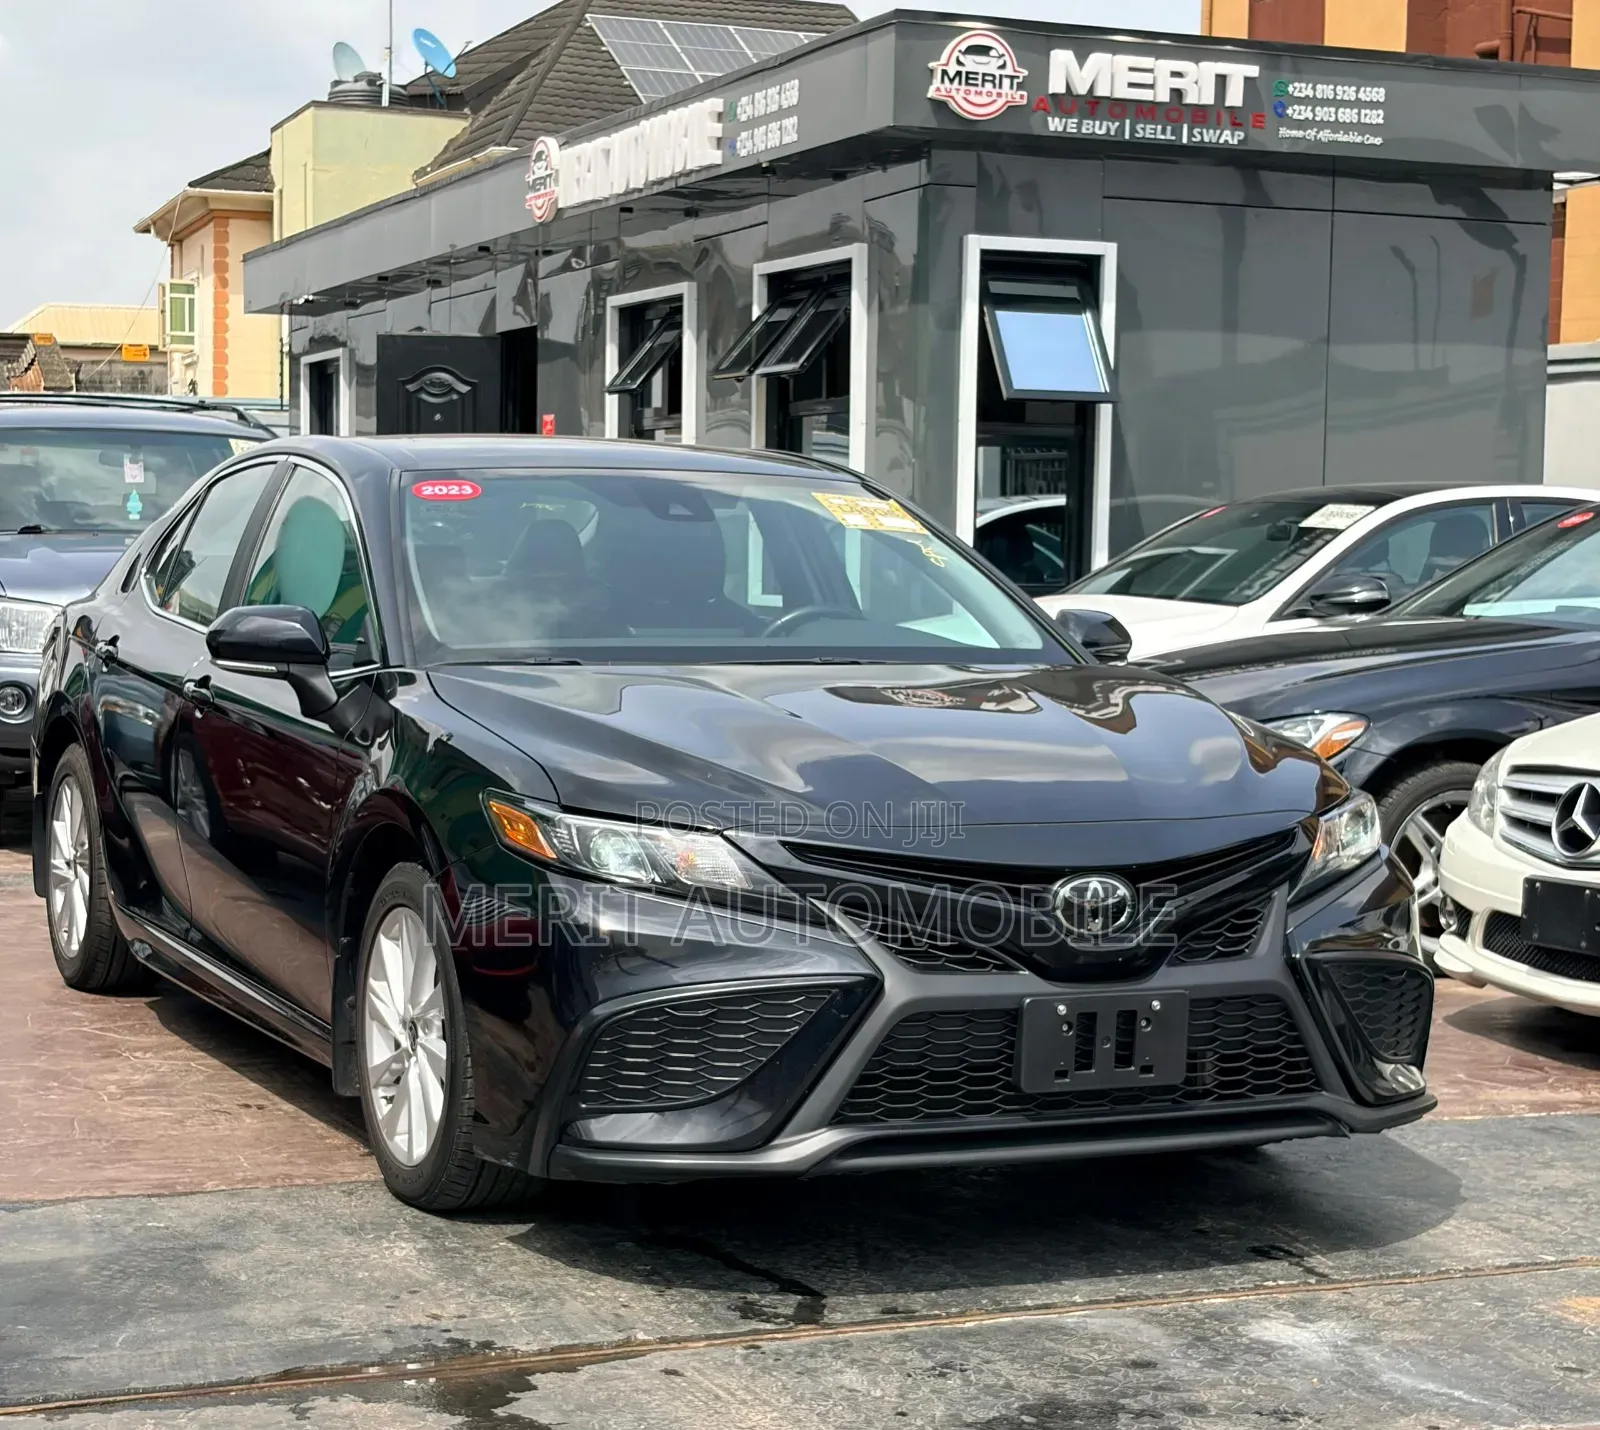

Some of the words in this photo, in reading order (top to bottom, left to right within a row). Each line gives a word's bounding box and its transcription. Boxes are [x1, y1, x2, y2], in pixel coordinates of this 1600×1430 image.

[941, 69, 1021, 91] MERIT
[1048, 49, 1260, 108] MERIT
[934, 86, 1025, 100] AUTOMOBILE
[1287, 82, 1314, 98] +234
[1315, 84, 1334, 99] 816
[1335, 85, 1357, 101] 926
[1357, 87, 1386, 102] 4568
[1032, 95, 1267, 130] AUTOMOBILE
[1286, 104, 1314, 120] +234
[1314, 106, 1336, 122] 903
[1337, 107, 1359, 123] 686
[1360, 109, 1385, 124] 1282
[1047, 116, 1078, 133] WE
[1081, 119, 1120, 136] BUY
[1134, 124, 1176, 140] SELL
[1191, 127, 1245, 145] SWAP
[421, 485, 473, 495] 2023
